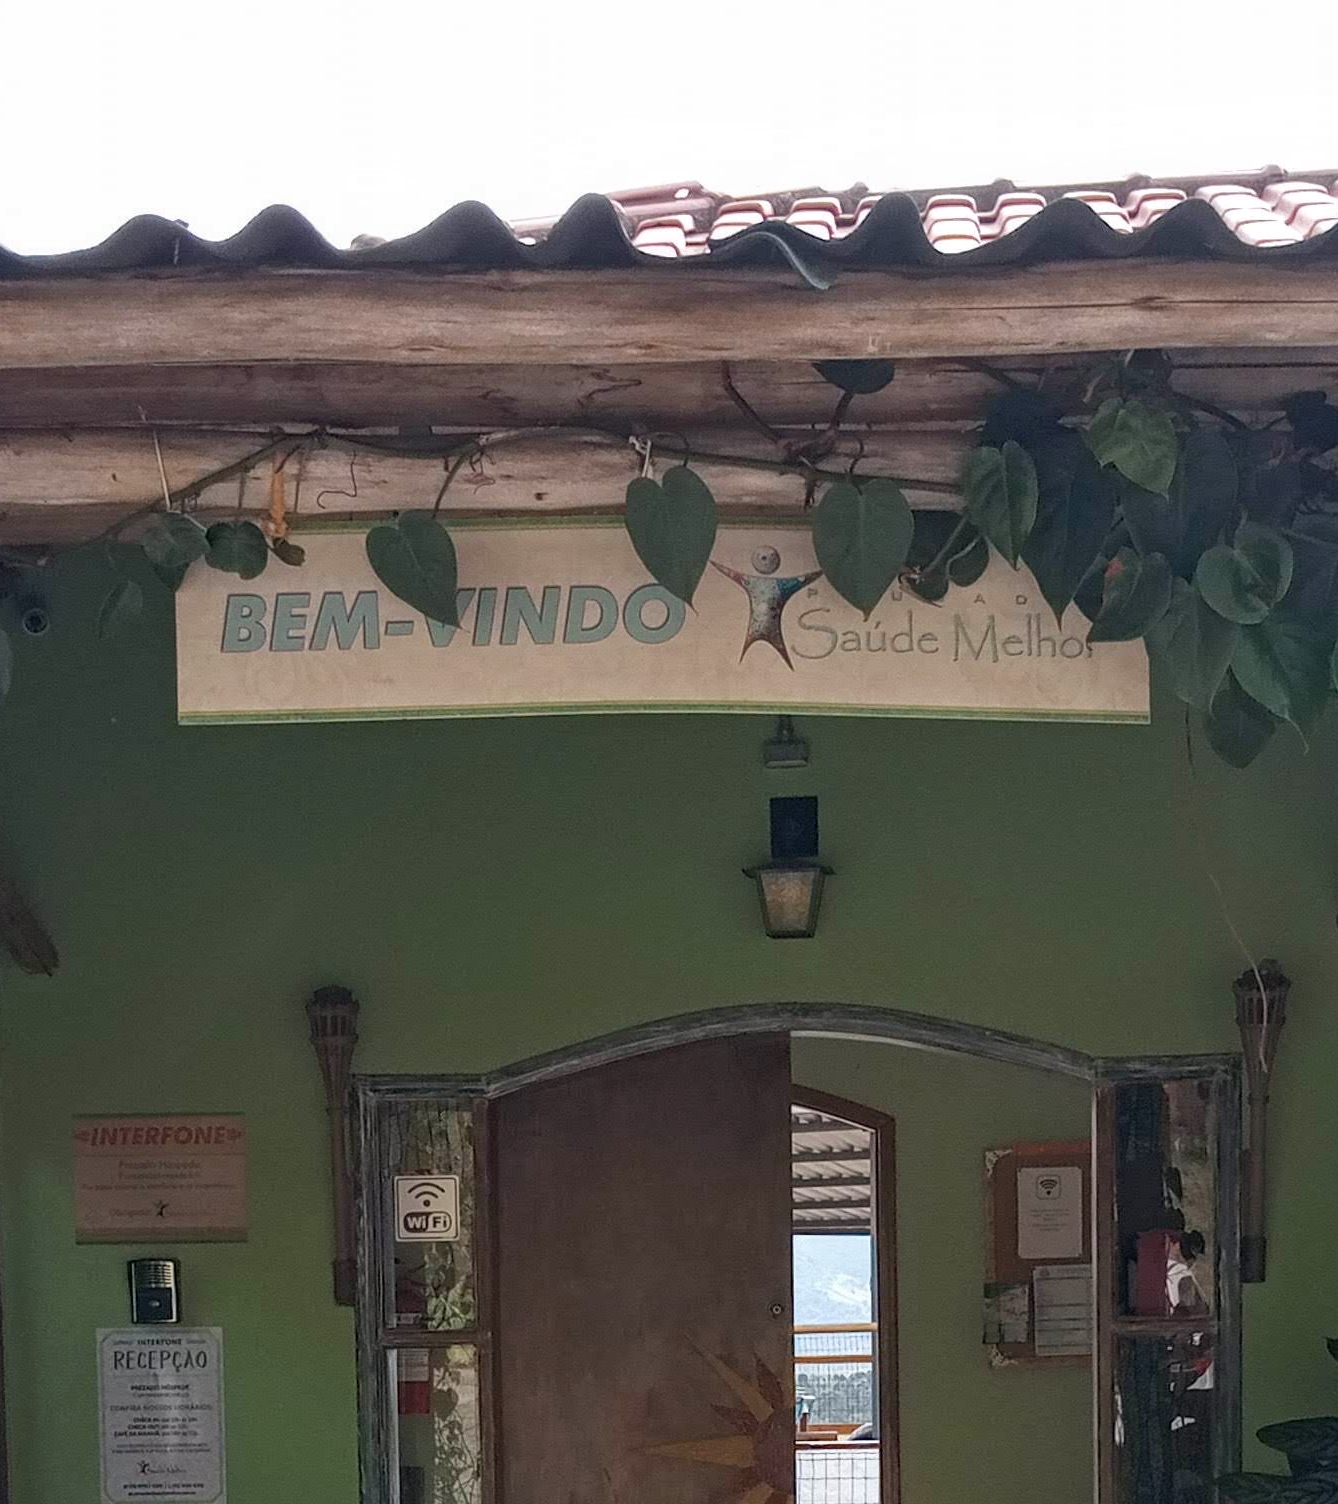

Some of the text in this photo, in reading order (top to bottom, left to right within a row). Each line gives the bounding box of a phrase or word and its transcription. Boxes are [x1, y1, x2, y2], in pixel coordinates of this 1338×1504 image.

[220, 582, 687, 653] BEM-VINDO
[790, 607, 940, 660] Saúde
[90, 1126, 226, 1146] INTERFONE
